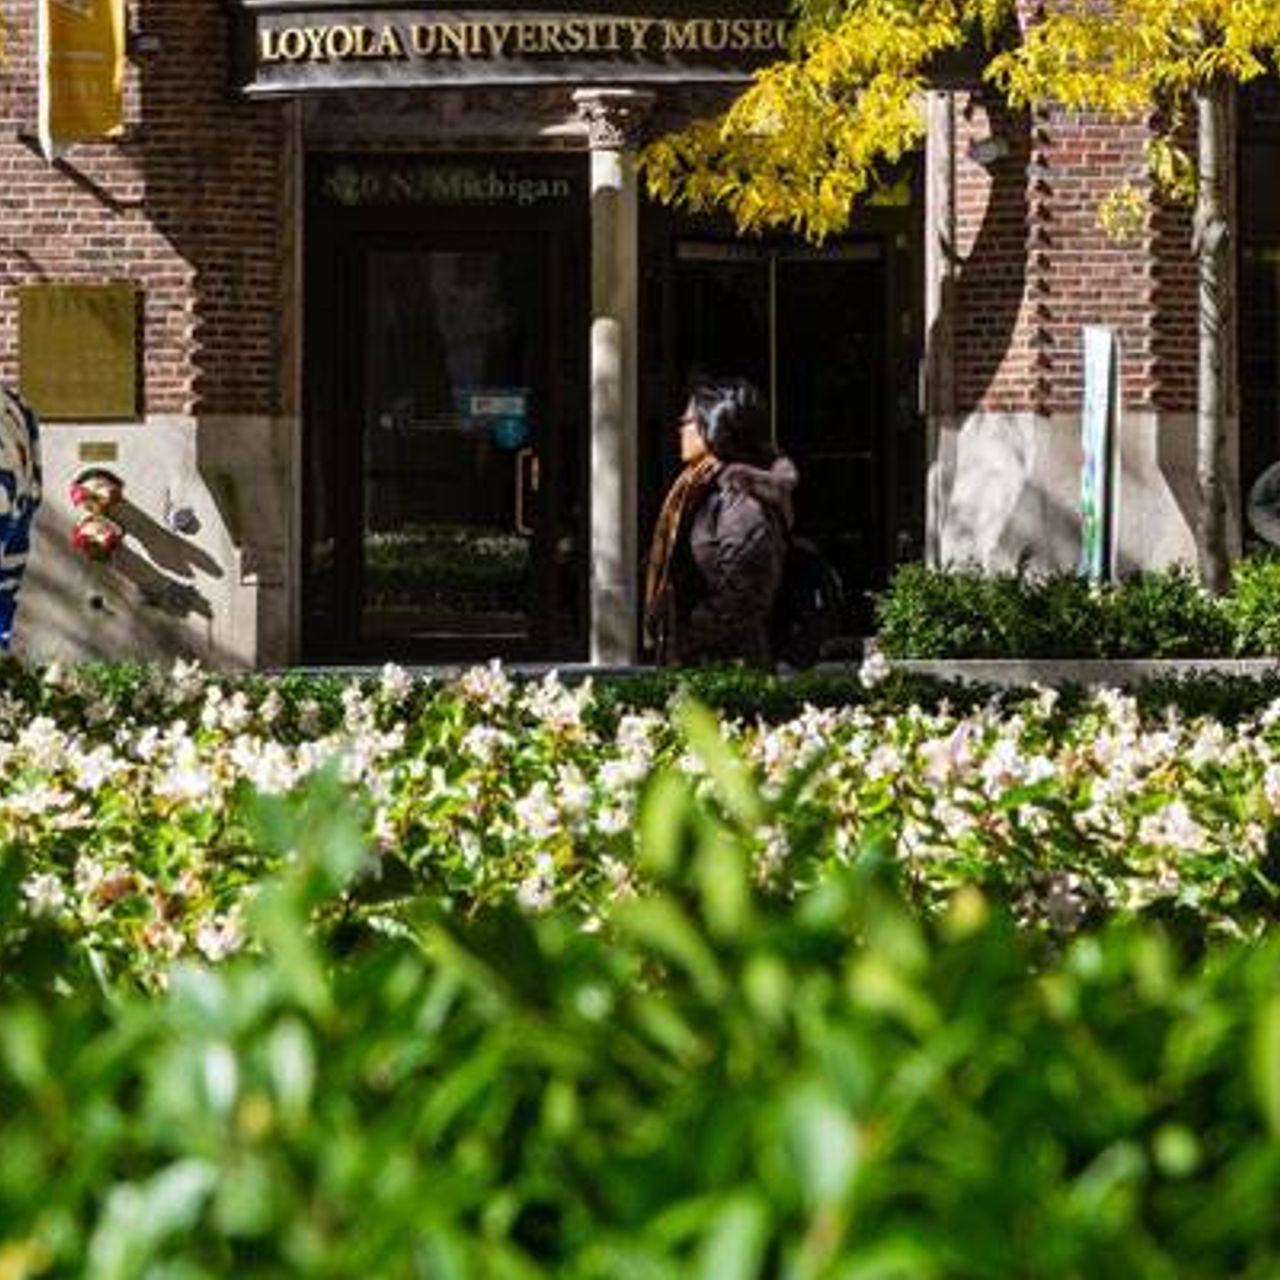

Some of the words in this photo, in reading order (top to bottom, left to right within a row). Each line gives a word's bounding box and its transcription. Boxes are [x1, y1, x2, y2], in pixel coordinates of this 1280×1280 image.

[260, 24, 403, 60] LOYOLA
[409, 19, 651, 54] UNIVERSITY
[663, 19, 789, 51] MUSE
[430, 169, 570, 206] Michigan
